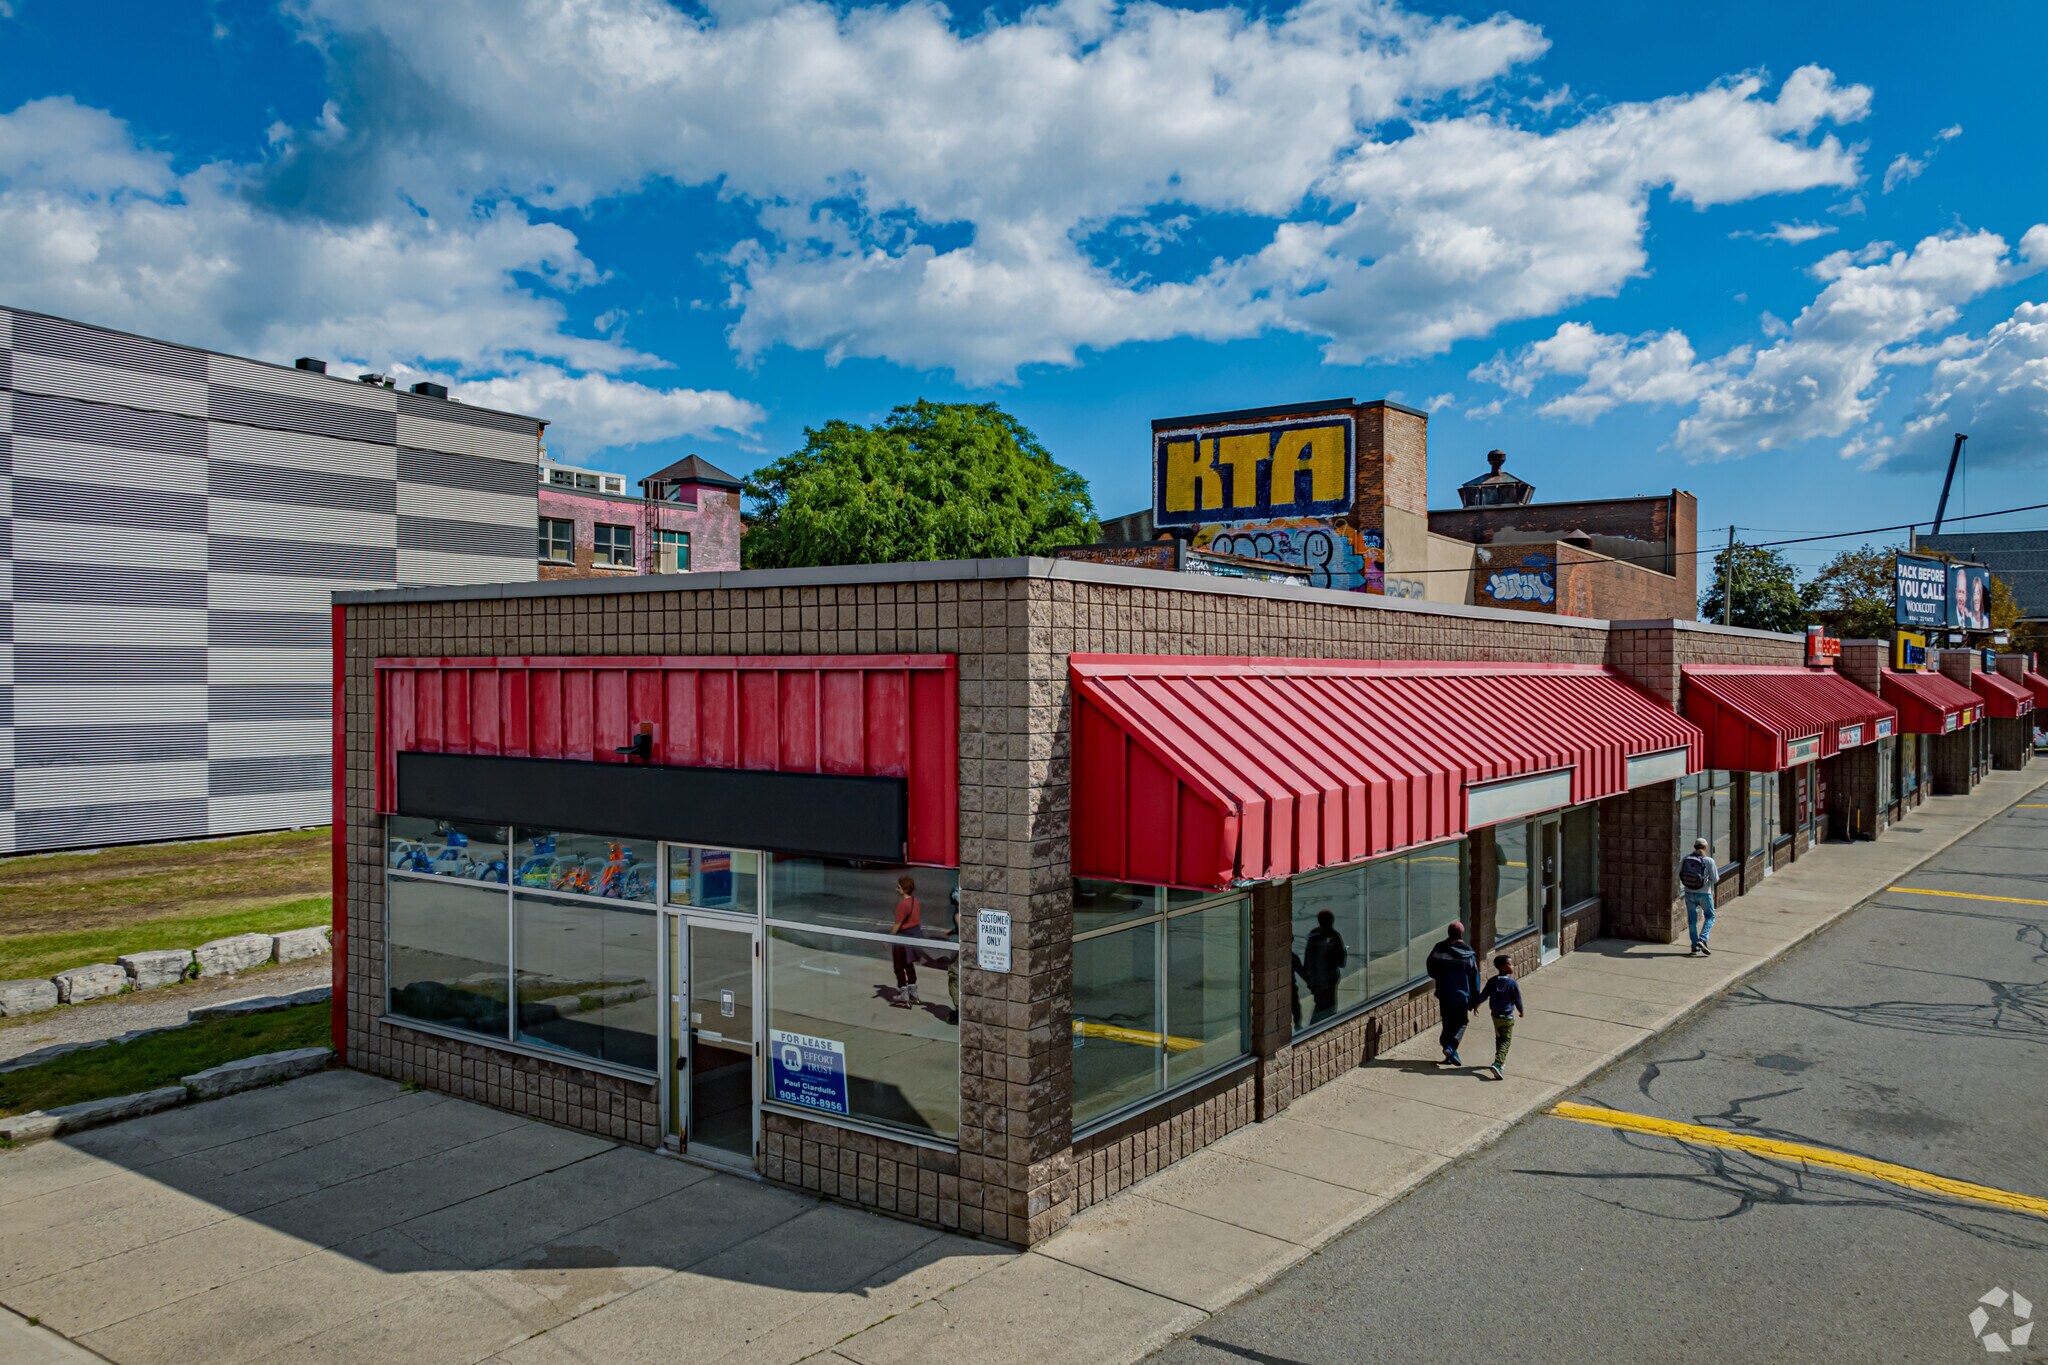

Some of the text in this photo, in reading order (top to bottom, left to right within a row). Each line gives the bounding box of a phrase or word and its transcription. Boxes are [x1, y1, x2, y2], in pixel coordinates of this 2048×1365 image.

[1166, 425, 1345, 513] KTA
[1898, 564, 1945, 582] PACK BEFORE
[1899, 579, 1945, 600] YOU CALL
[1906, 600, 1936, 614] WOOLCOTT
[980, 912, 1009, 926] CUSTOMER
[981, 924, 1007, 937] PARKING
[986, 936, 1001, 946] ONLY
[781, 1033, 833, 1051] FOR LEASE
[803, 1051, 834, 1065] EFFORT
[806, 1062, 833, 1075] TRUST
[784, 1079, 801, 1088] Paul
